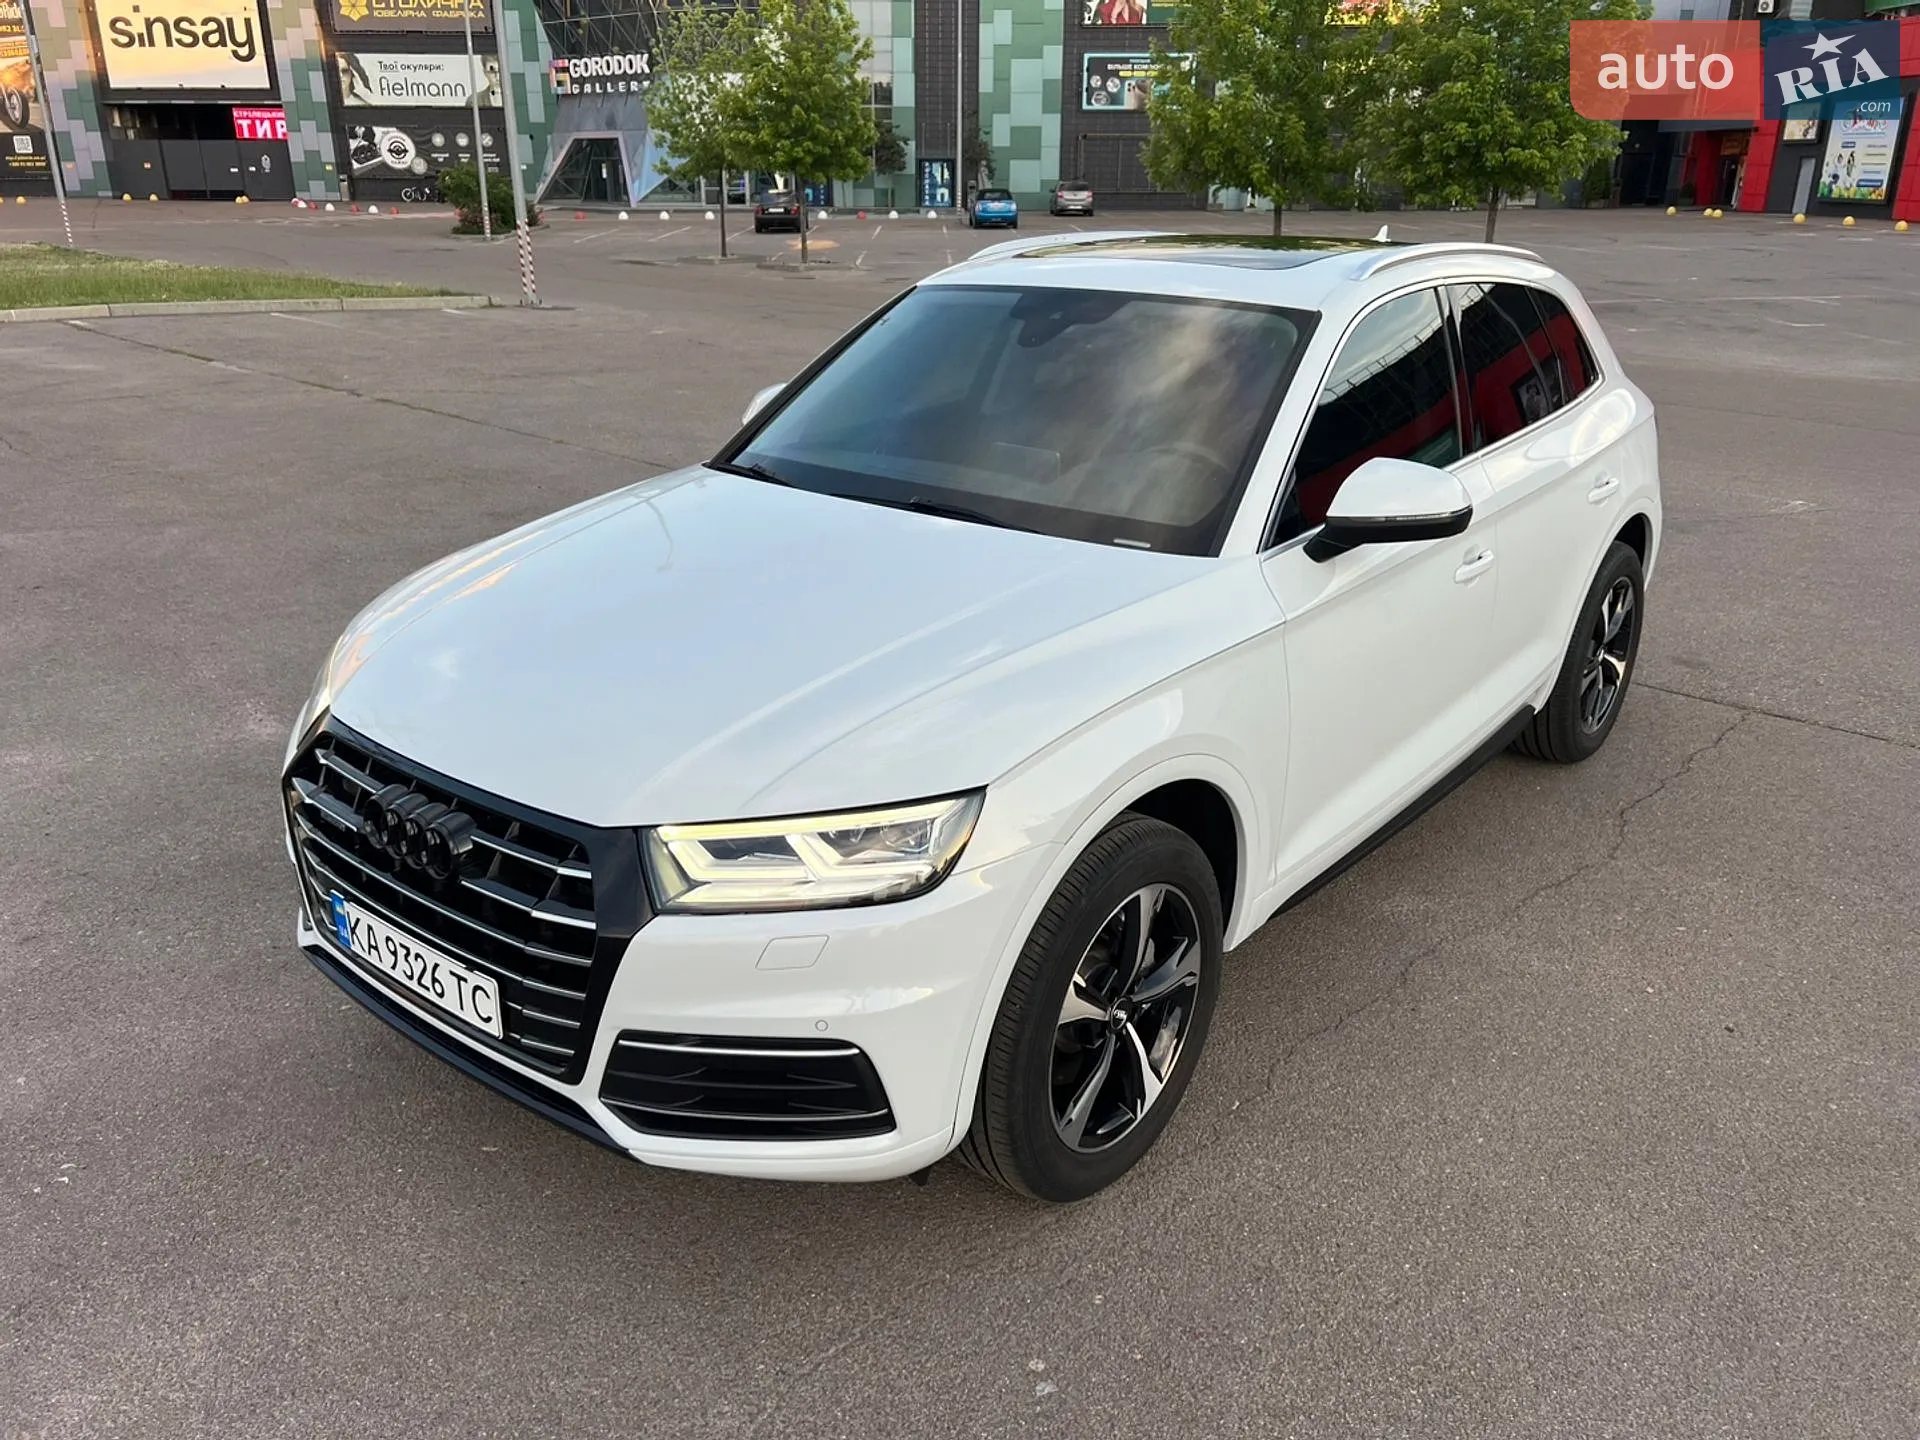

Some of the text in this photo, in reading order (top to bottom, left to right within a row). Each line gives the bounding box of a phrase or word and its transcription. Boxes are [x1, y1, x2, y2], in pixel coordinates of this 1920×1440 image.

[373, 9, 427, 18] ЮВЕЛІРНА
[109, 4, 256, 63] sinsay
[569, 53, 650, 78] GORODOK
[237, 119, 287, 139] ТИР
[346, 911, 493, 1024] KA 9326 TC
